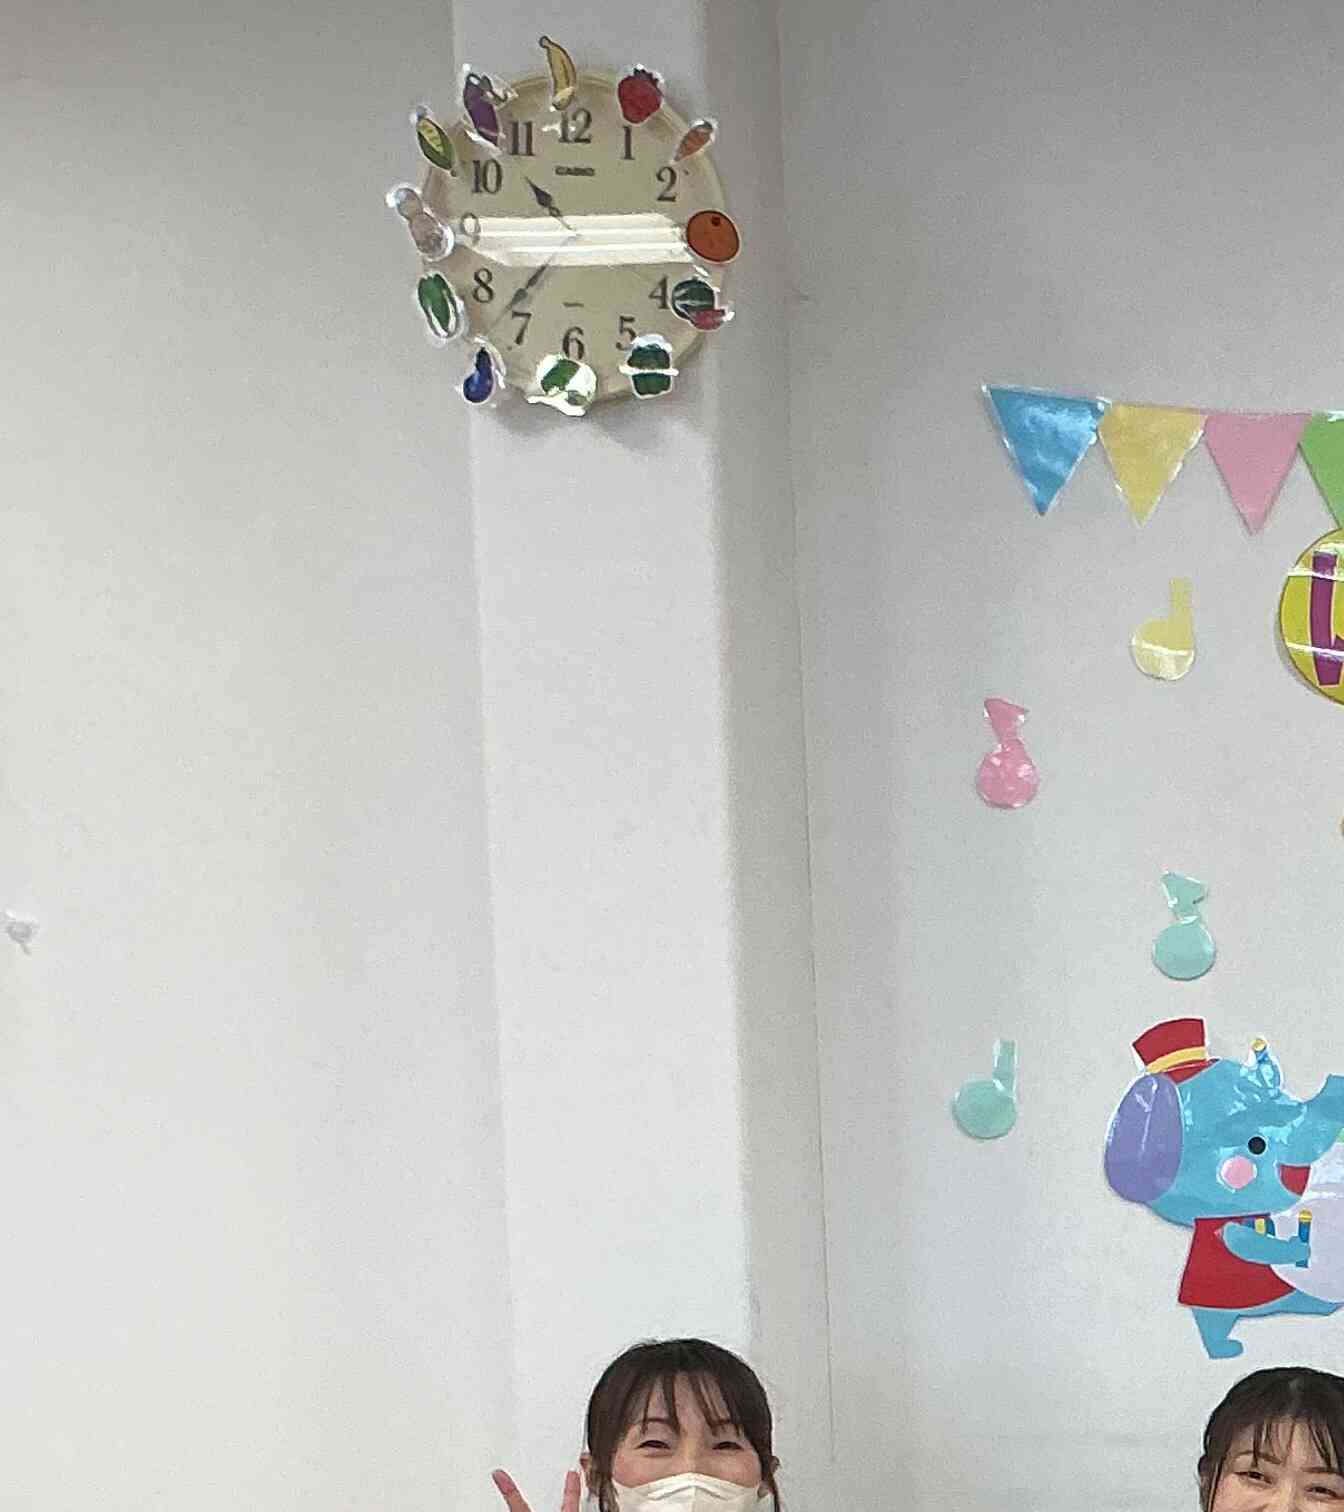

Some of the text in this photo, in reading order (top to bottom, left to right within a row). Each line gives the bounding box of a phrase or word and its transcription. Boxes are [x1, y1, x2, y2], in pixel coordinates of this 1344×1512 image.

[508, 120, 536, 156] 11
[558, 107, 592, 143] 12
[622, 125, 636, 161] 1
[471, 158, 503, 194] 10
[655, 166, 678, 202] 2
[472, 268, 495, 303] 8
[648, 274, 671, 310] 4
[511, 310, 532, 345] 7
[561, 326, 586, 360] 6
[615, 315, 638, 351] 5
